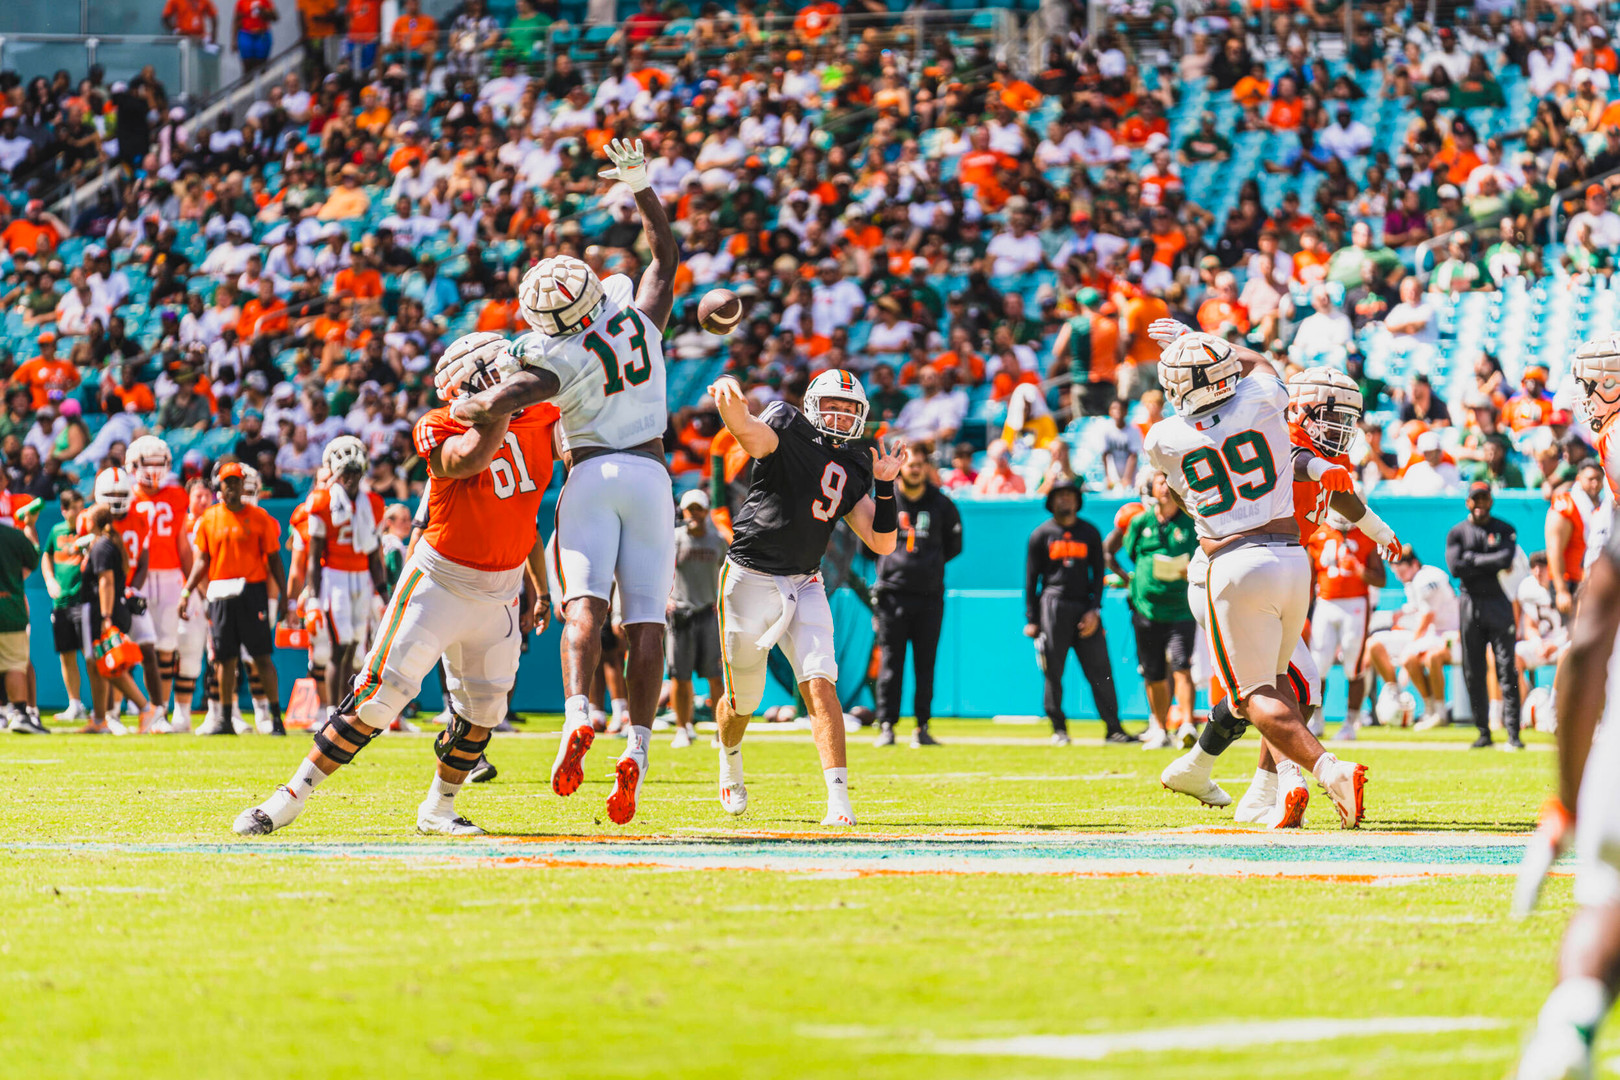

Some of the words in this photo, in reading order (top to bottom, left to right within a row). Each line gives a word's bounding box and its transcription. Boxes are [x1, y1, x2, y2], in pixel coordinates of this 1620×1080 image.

[582, 305, 652, 397] 13
[489, 431, 537, 499] 61
[812, 460, 848, 522] 9
[1180, 429, 1278, 518] 99
[136, 501, 174, 536] 72
[1220, 503, 1260, 526] DOUGLAS
